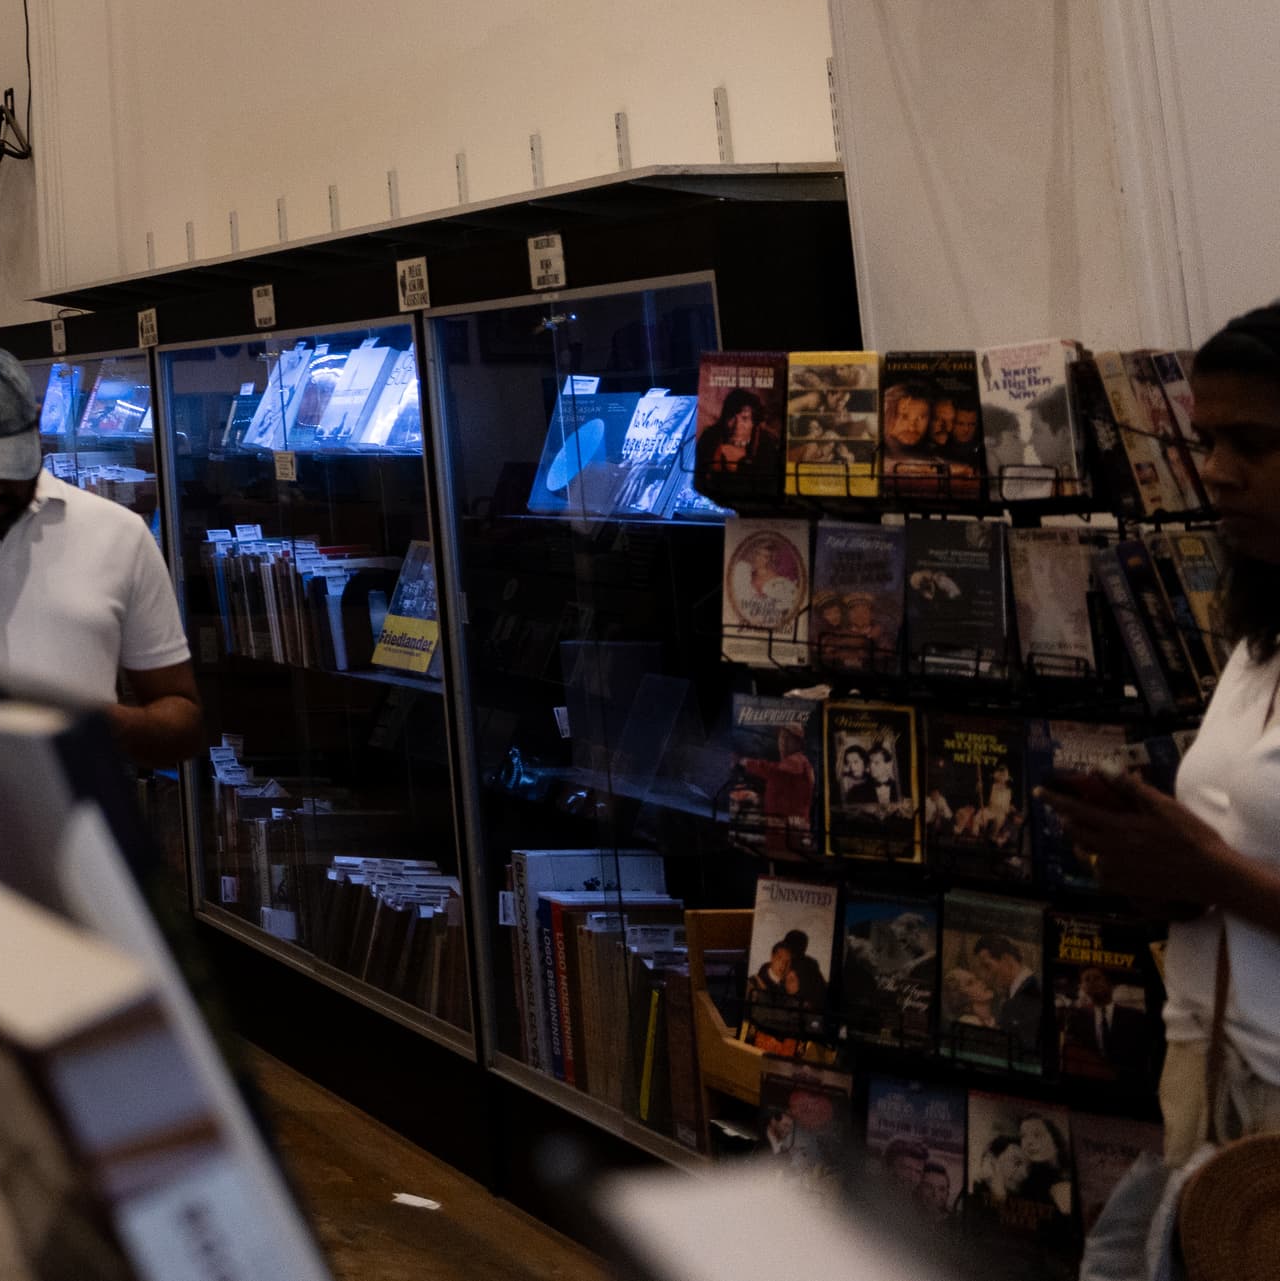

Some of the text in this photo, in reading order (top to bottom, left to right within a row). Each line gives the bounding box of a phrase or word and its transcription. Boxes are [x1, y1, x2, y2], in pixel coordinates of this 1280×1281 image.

[709, 376, 737, 388] LITTLE
[754, 377, 775, 389] MAN
[378, 628, 434, 654] Friedlander
[952, 730, 998, 744] WHO'S
[770, 883, 832, 907] UNINVITED
[555, 931, 567, 971] LOGO
[1058, 945, 1137, 969] KENNEDY
[542, 927, 563, 1057] LOGO BEGINNINGS
